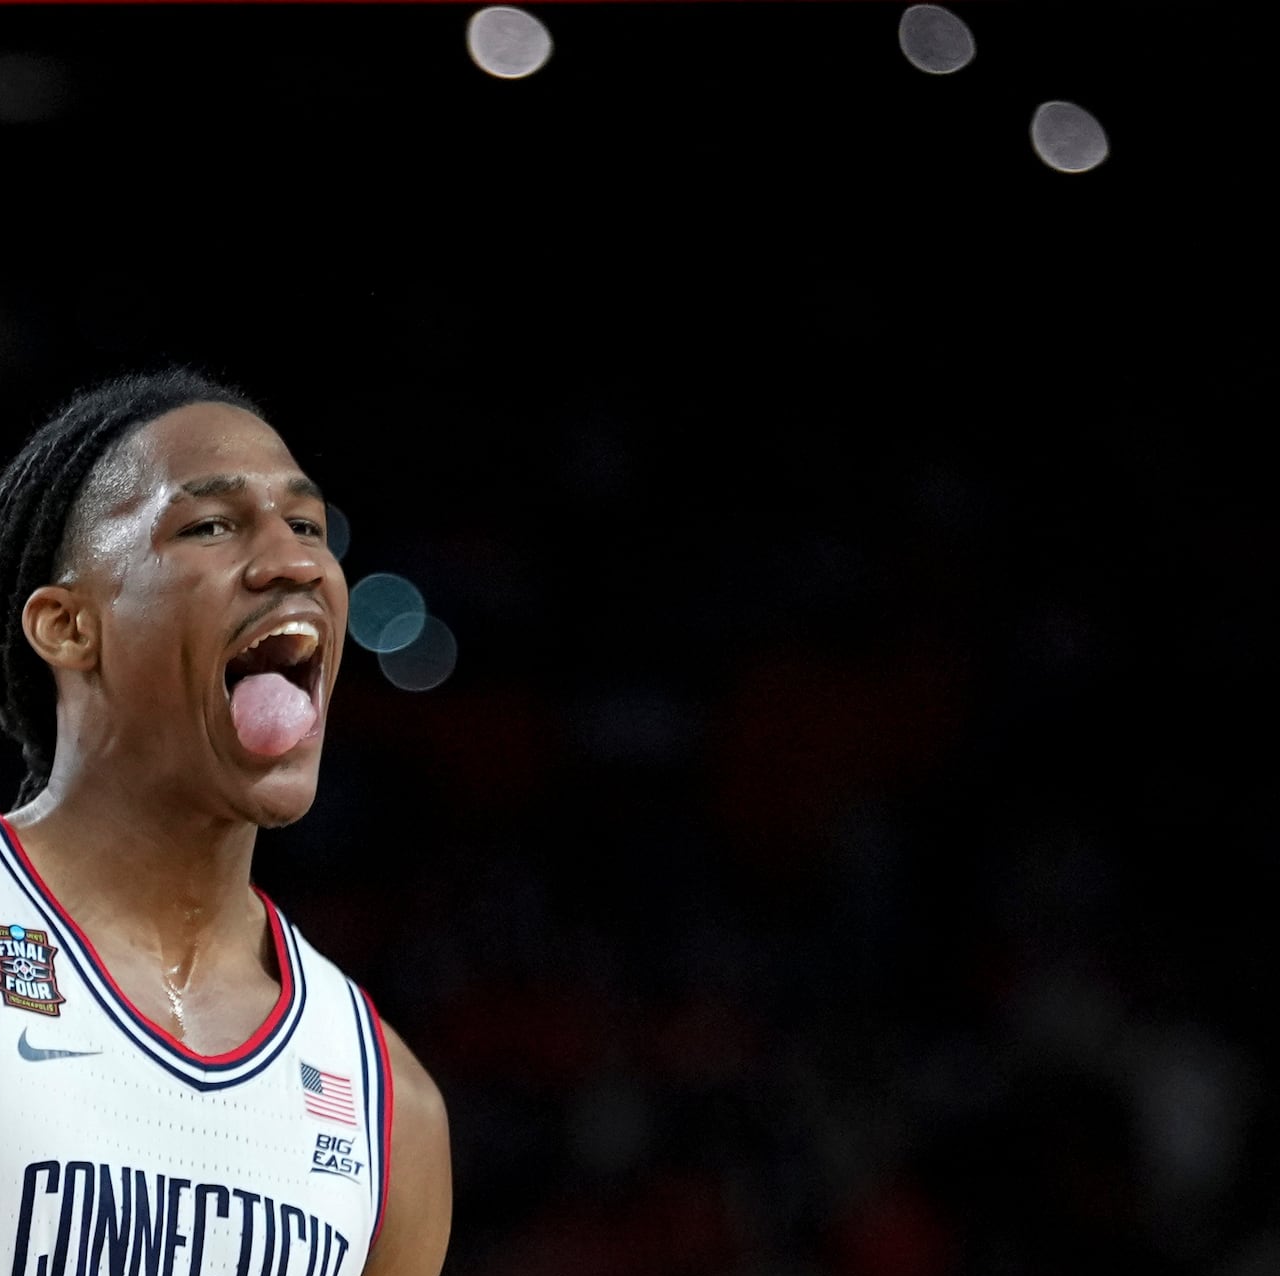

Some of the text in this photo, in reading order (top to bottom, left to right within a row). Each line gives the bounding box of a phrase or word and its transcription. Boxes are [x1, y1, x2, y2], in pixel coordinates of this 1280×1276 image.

[5, 976, 52, 999] FOUR
[315, 1133, 356, 1155] BIG
[312, 1150, 365, 1176] EAST
